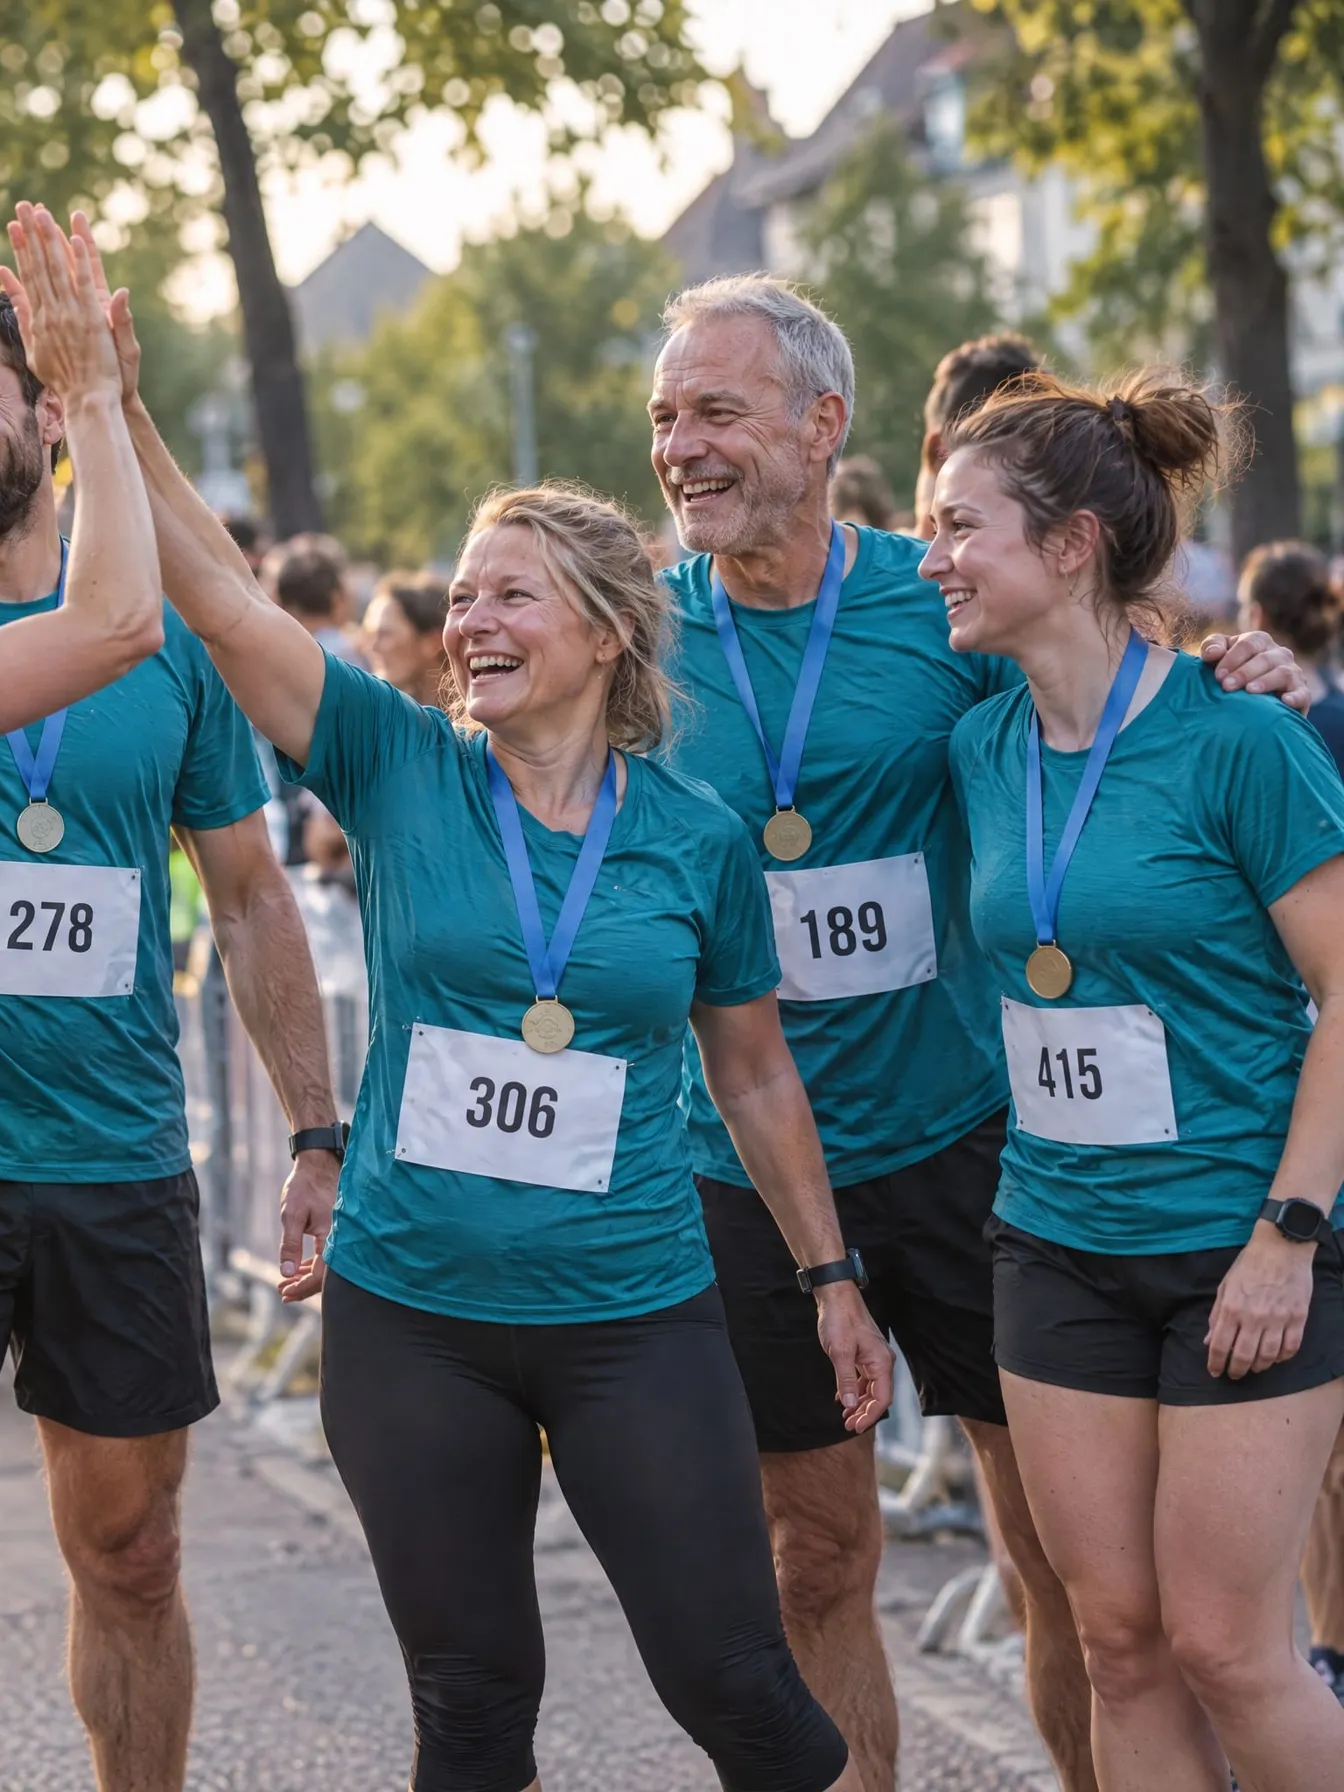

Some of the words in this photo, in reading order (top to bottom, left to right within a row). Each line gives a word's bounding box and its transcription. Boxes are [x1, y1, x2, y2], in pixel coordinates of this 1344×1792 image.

[6, 899, 94, 954] 278
[799, 900, 888, 960] 189
[1037, 1046, 1103, 1101] 415
[465, 1076, 558, 1139] 306
